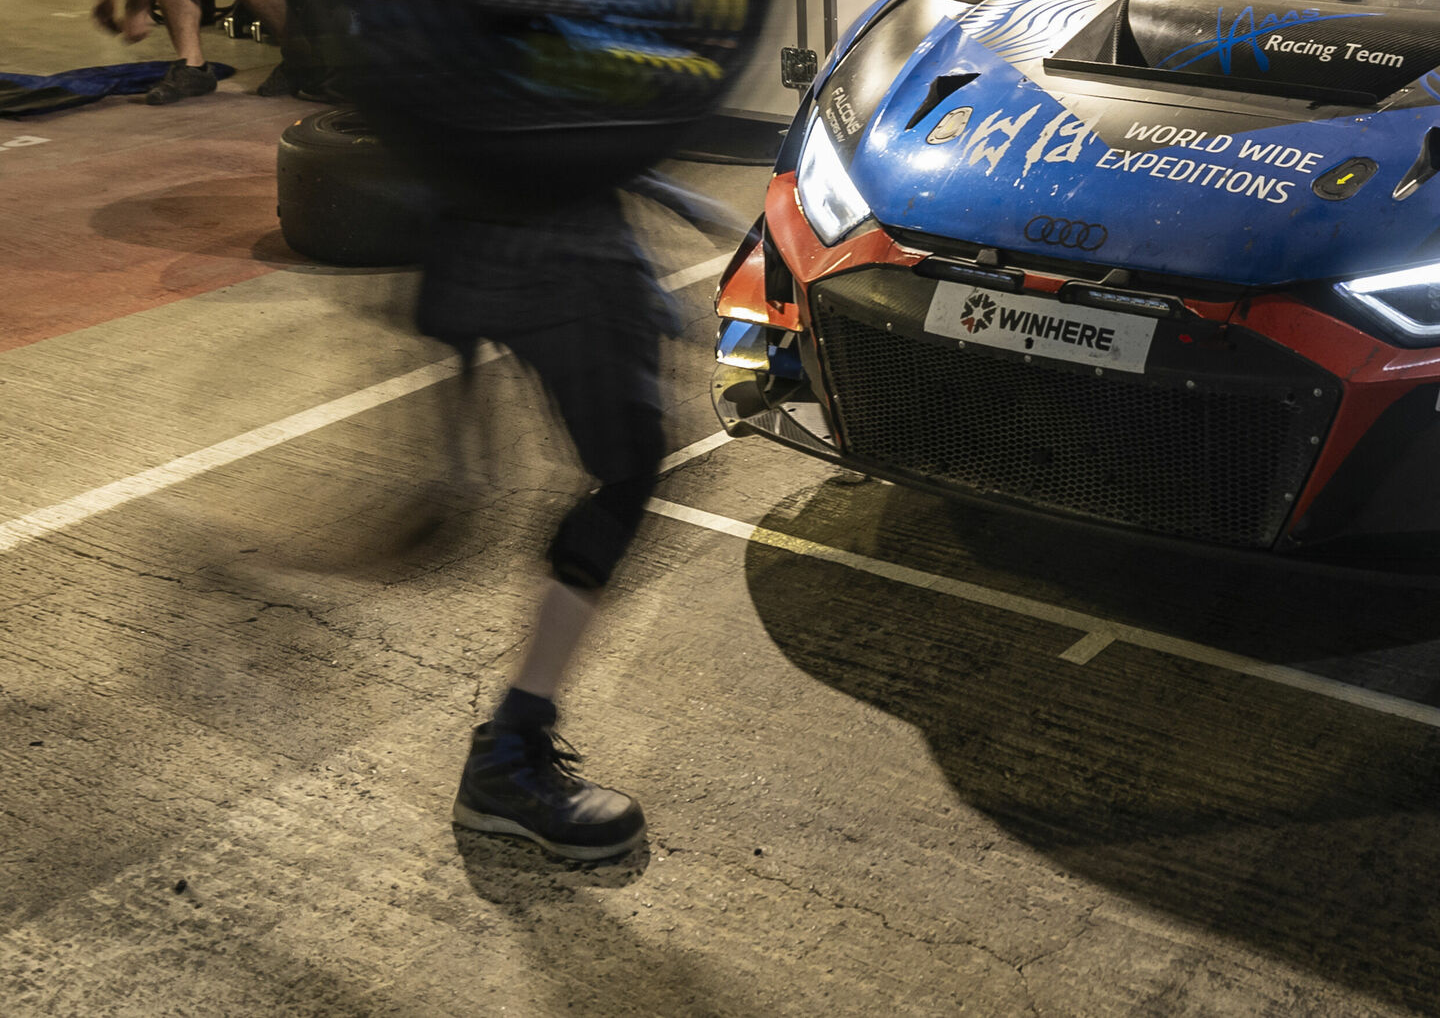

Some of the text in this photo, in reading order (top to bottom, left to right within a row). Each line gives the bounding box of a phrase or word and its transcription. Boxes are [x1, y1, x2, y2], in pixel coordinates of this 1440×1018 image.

[1264, 35, 1405, 69] Racing Team
[1124, 121, 1324, 174] WORLD WIDE
[1096, 148, 1297, 205] EXPEDITIONS
[998, 306, 1116, 352] WINHERE
